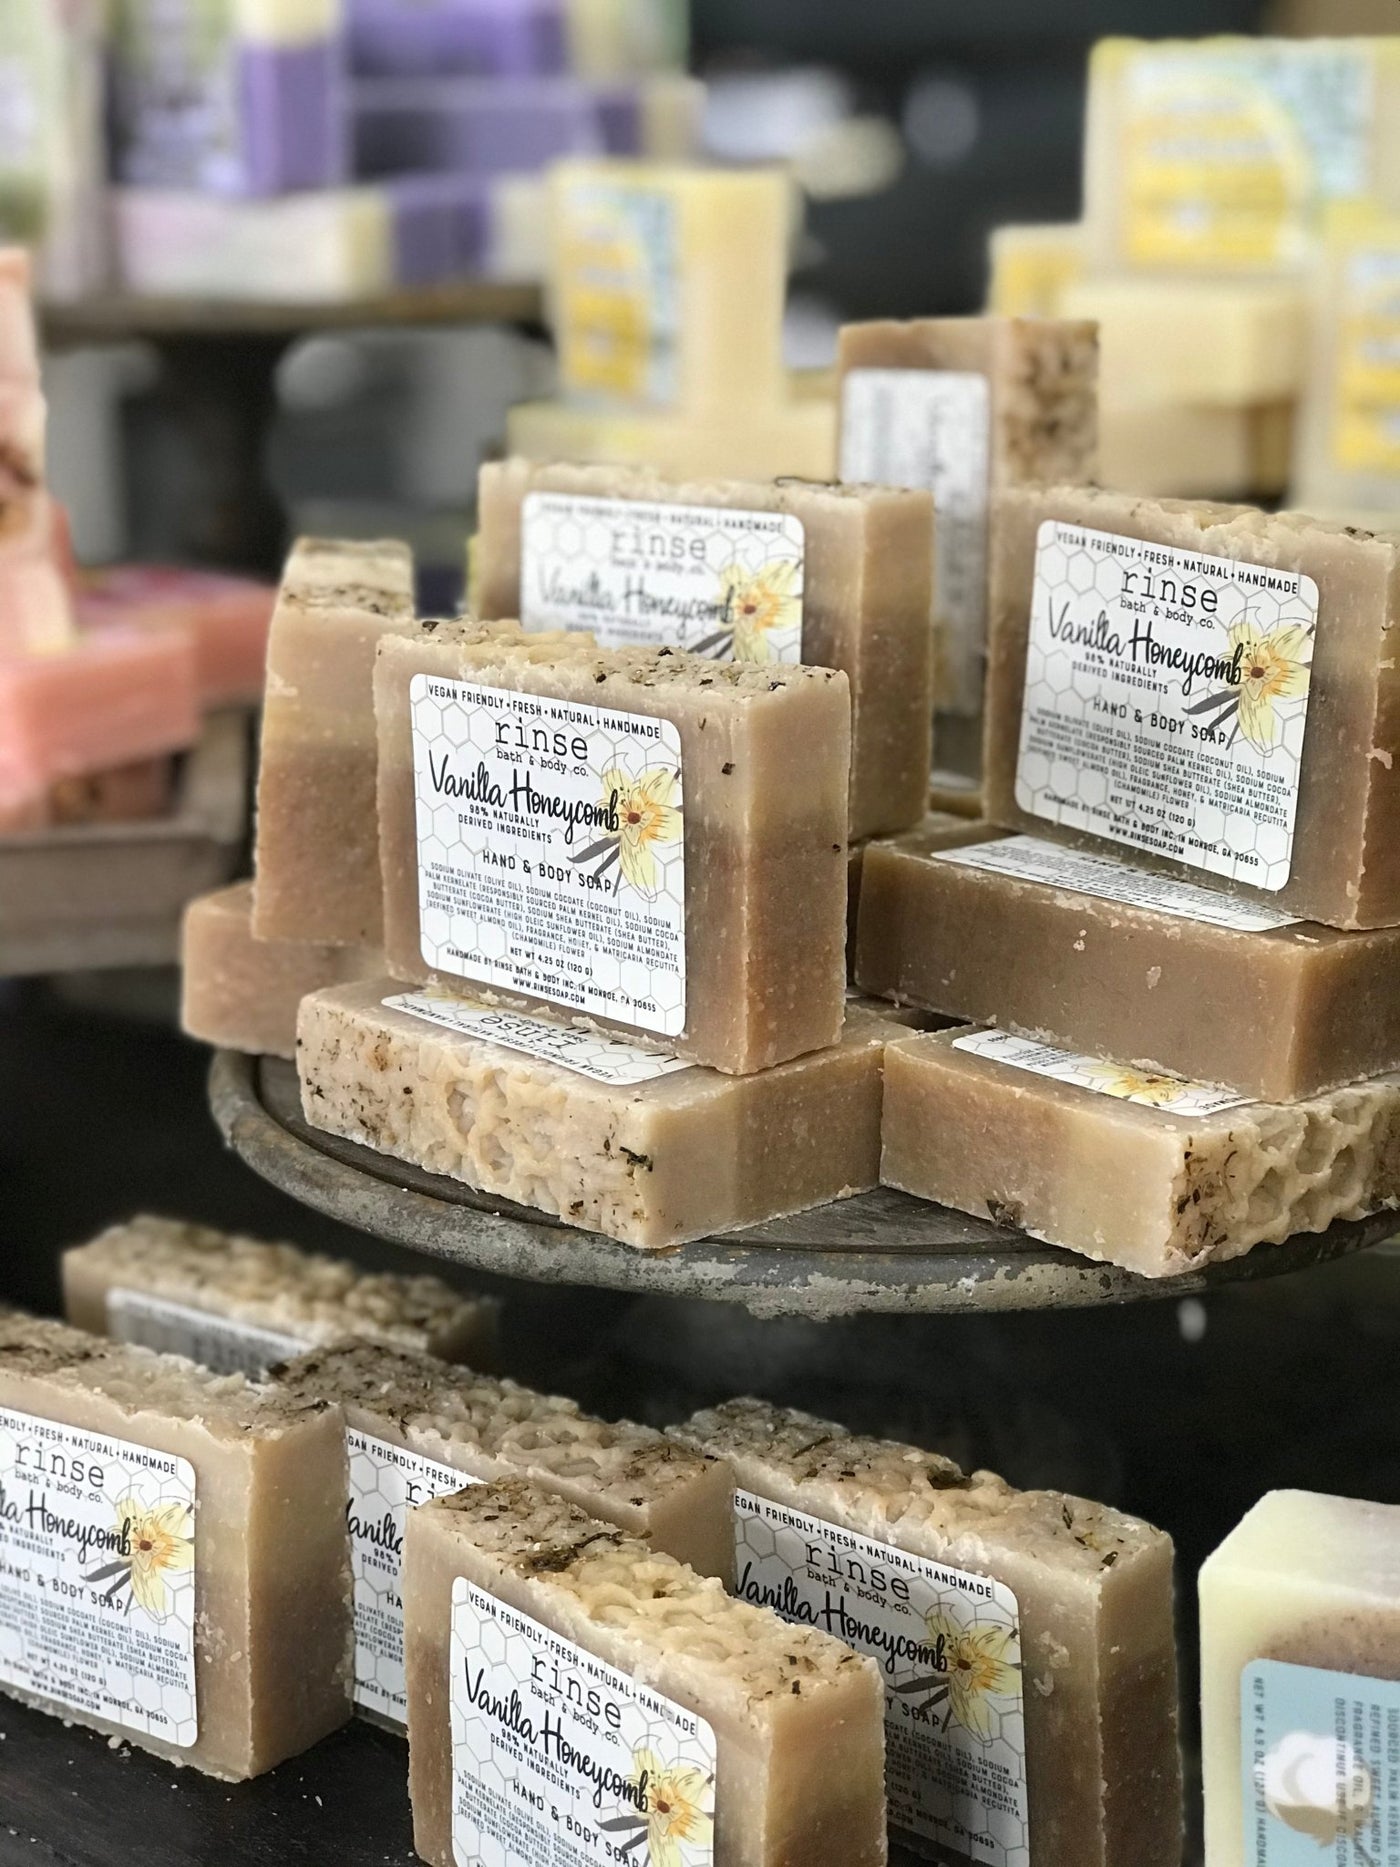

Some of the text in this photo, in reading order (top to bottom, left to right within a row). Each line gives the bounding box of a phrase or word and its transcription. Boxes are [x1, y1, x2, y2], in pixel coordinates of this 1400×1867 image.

[612, 526, 706, 560] rinse
[1057, 531, 1296, 594] VEGAN FRIENDLY FRESH NATURAL HANDMADE
[624, 575, 735, 640] Honeycomb
[1120, 566, 1217, 613] rinse
[1120, 596, 1215, 629] bath & body co.
[1048, 595, 1243, 696] Vanilla Honeycomb
[1071, 660, 1168, 694] DERIVED INGREDIENTS
[428, 685, 659, 739] VEGAN FRIENDLY FRESH NATURAL HANDMADE
[1092, 697, 1226, 745] HAND & BODY SOAP
[495, 716, 588, 760] rinse
[496, 747, 588, 776] bath & body co.
[428, 749, 620, 845] Vanilla Honeycomb
[469, 804, 539, 827] 98% NATURALLY
[458, 813, 552, 844] DERIVED INGREDIENTS
[482, 849, 611, 892] HAND & BODY SOAP
[495, 897, 670, 951] BUTTER), SODIUM SHEA BUTTERATE (SHEA BUTTER),
[507, 880, 671, 929] OIL), SODIUM COCOATE (COCONUT OIL), SODIUM
[526, 895, 678, 941] SOURCED PALM KERNEL OIL), SODIUM COCOA
[515, 932, 585, 957] (CHAMOMILE) FLOWER
[525, 915, 677, 962] OLEIC SUNFLOWER OIL), SODIUM ALMONDATE
[513, 978, 585, 1004] WWW.RINSESOAP.COM
[479, 1015, 577, 1049] rinse
[13, 1441, 103, 1488] rinse
[34, 1425, 176, 1474] FRESH NATURAL HANDMADE
[371, 1444, 456, 1489] FRIENDLY FRESH
[25, 1489, 132, 1565] Honeycomb
[735, 1495, 991, 1598] EGAN FRIENDLY FRESH NATURAL HANDMADE
[362, 1553, 398, 1576] DERIVED
[804, 1543, 910, 1600] rinse
[37, 1573, 45, 1587] &
[52, 1578, 84, 1599] BODY
[90, 1591, 122, 1611] SOAP
[805, 1567, 911, 1616] bath & body co.
[821, 1590, 948, 1674] Honeycomb
[469, 1592, 695, 1735] VEGAN FRIENDLY FRESH NATURAL HANADE
[530, 1654, 621, 1729] rinse
[530, 1681, 620, 1746] bath & body co.
[901, 1702, 939, 1726] SOAP
[465, 1657, 649, 1813] Vanilla Honeycomb
[502, 1728, 568, 1778] 98% NATURALLY
[490, 1733, 580, 1800] DERIVED INGREDIENTS
[512, 1778, 544, 1811] HAND
[550, 1805, 559, 1822] &
[566, 1814, 598, 1847] BODY
